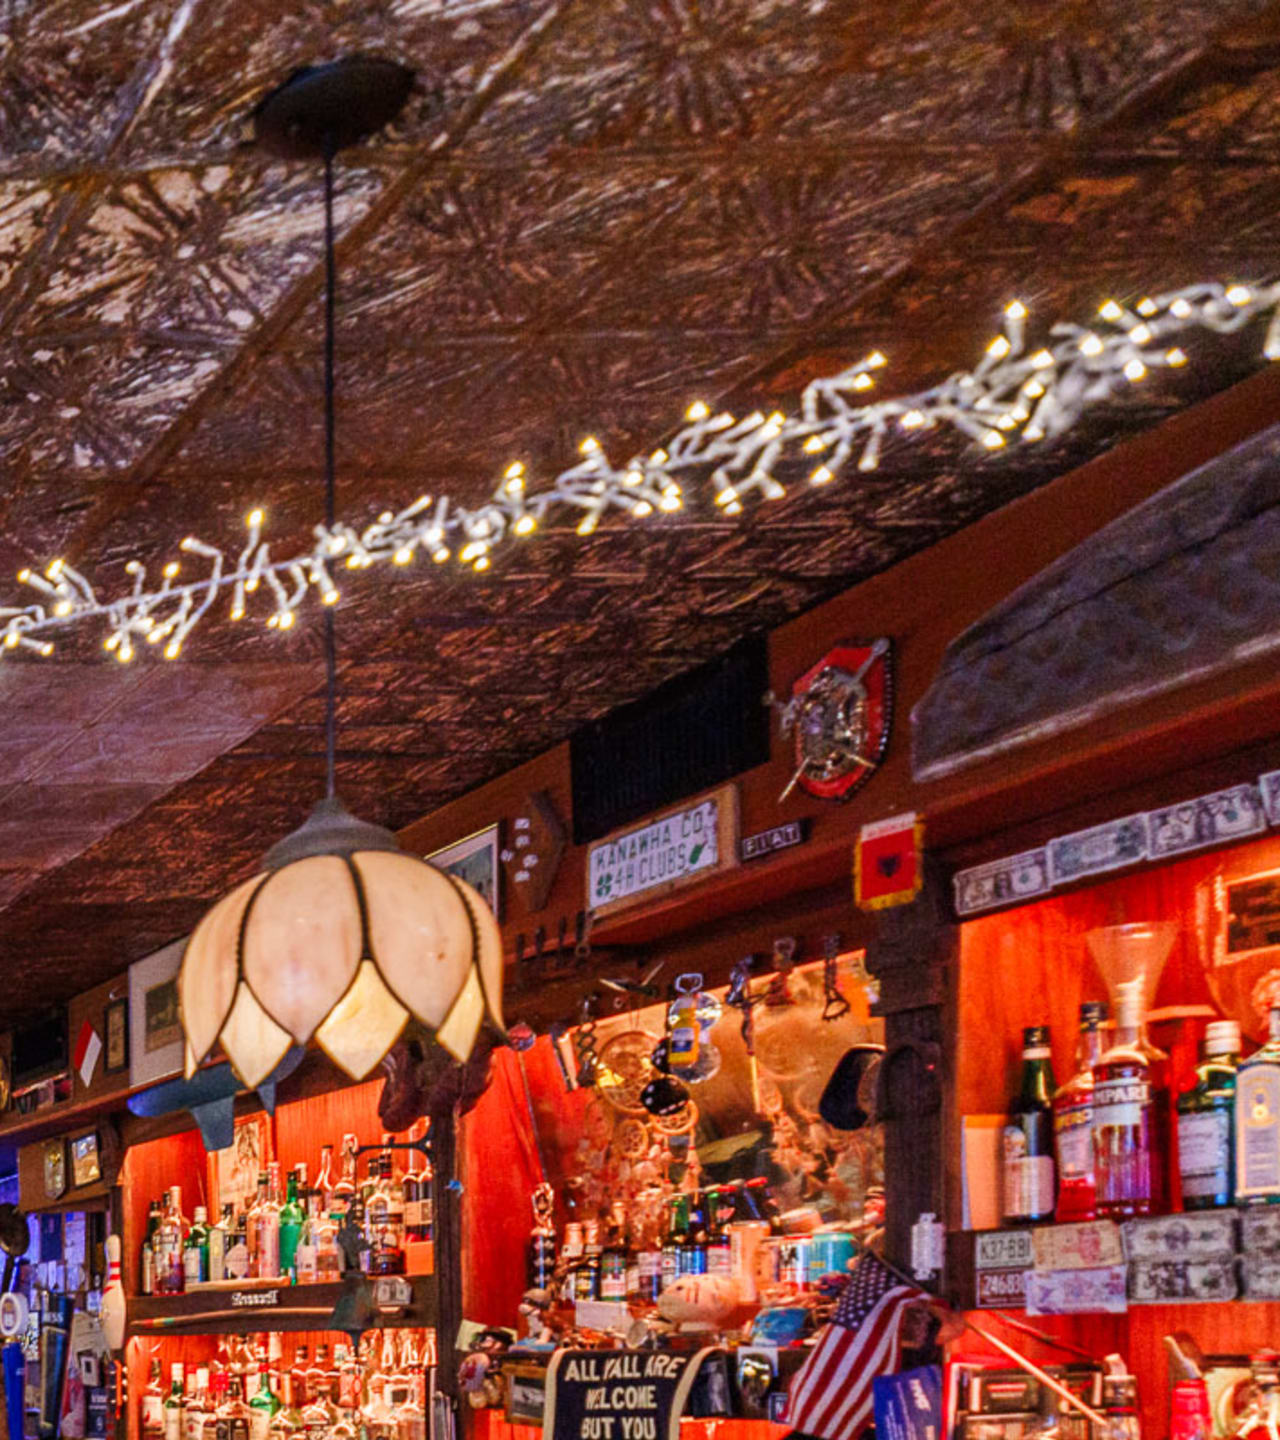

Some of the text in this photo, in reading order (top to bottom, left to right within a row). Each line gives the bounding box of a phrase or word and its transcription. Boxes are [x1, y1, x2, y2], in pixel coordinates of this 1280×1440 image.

[597, 825, 672, 871] KANAWHA
[745, 824, 800, 853] FIAT
[640, 843, 687, 884] CLUBS
[564, 1359, 601, 1382] ALL
[644, 1354, 687, 1379] ARE
[580, 1416, 657, 1440] BUT YOU
